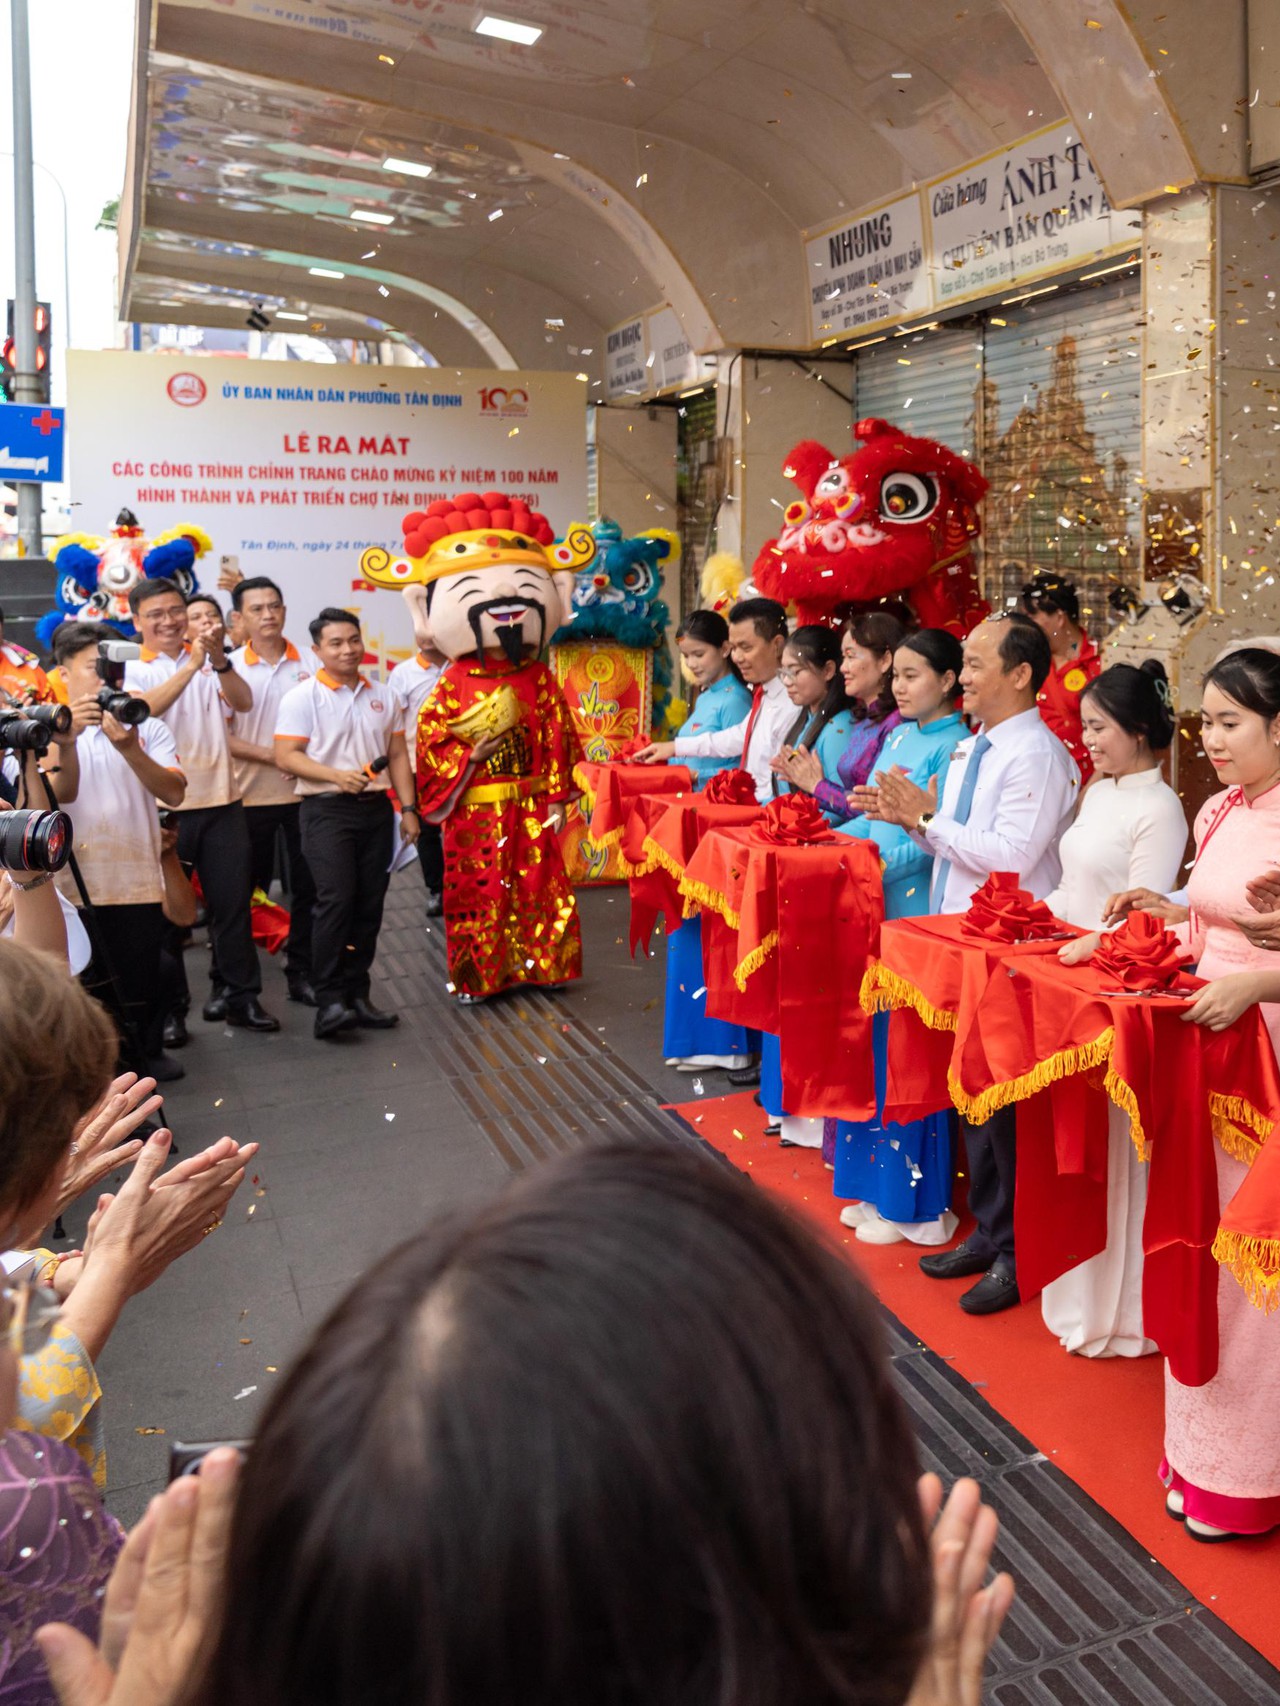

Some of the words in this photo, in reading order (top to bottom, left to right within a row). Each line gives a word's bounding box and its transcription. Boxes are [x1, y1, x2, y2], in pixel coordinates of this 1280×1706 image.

[1000, 160, 1059, 212] ÁNH
[1005, 213, 1038, 248] BÁN
[1042, 190, 1093, 236] QUẦN
[829, 212, 893, 269] NHUNG
[244, 386, 272, 400] BAN
[276, 386, 314, 402] NHÂN
[318, 387, 345, 403] DÂN
[405, 391, 429, 406] TÂN
[432, 393, 462, 409] ĐỊNH
[283, 430, 310, 453] LỄ
[318, 435, 352, 454] RA
[358, 433, 410, 456] MẮT
[112, 459, 144, 477] CÁC
[150, 459, 193, 478] CÔNG
[198, 461, 243, 479] TRÌNH
[248, 461, 294, 480] CHỈNH
[300, 466, 346, 481] TRANG
[351, 464, 389, 482] CHÀO
[394, 465, 435, 483] MỪNG
[439, 464, 456, 483] KỶ
[461, 467, 496, 485] NIỆM
[501, 470, 524, 483] 100
[528, 467, 558, 484] NĂM
[137, 485, 175, 503] HÌNH
[180, 486, 231, 504] THÀNH
[236, 487, 256, 505] VÀ
[260, 487, 298, 504] PHÁT
[303, 485, 345, 505] TRIỂN
[350, 490, 378, 510] CHỢ
[382, 489, 409, 506] TÂN
[240, 540, 262, 550] Tân
[303, 540, 332, 552] ngày
[335, 540, 350, 550] 24
[390, 540, 397, 550] 7
